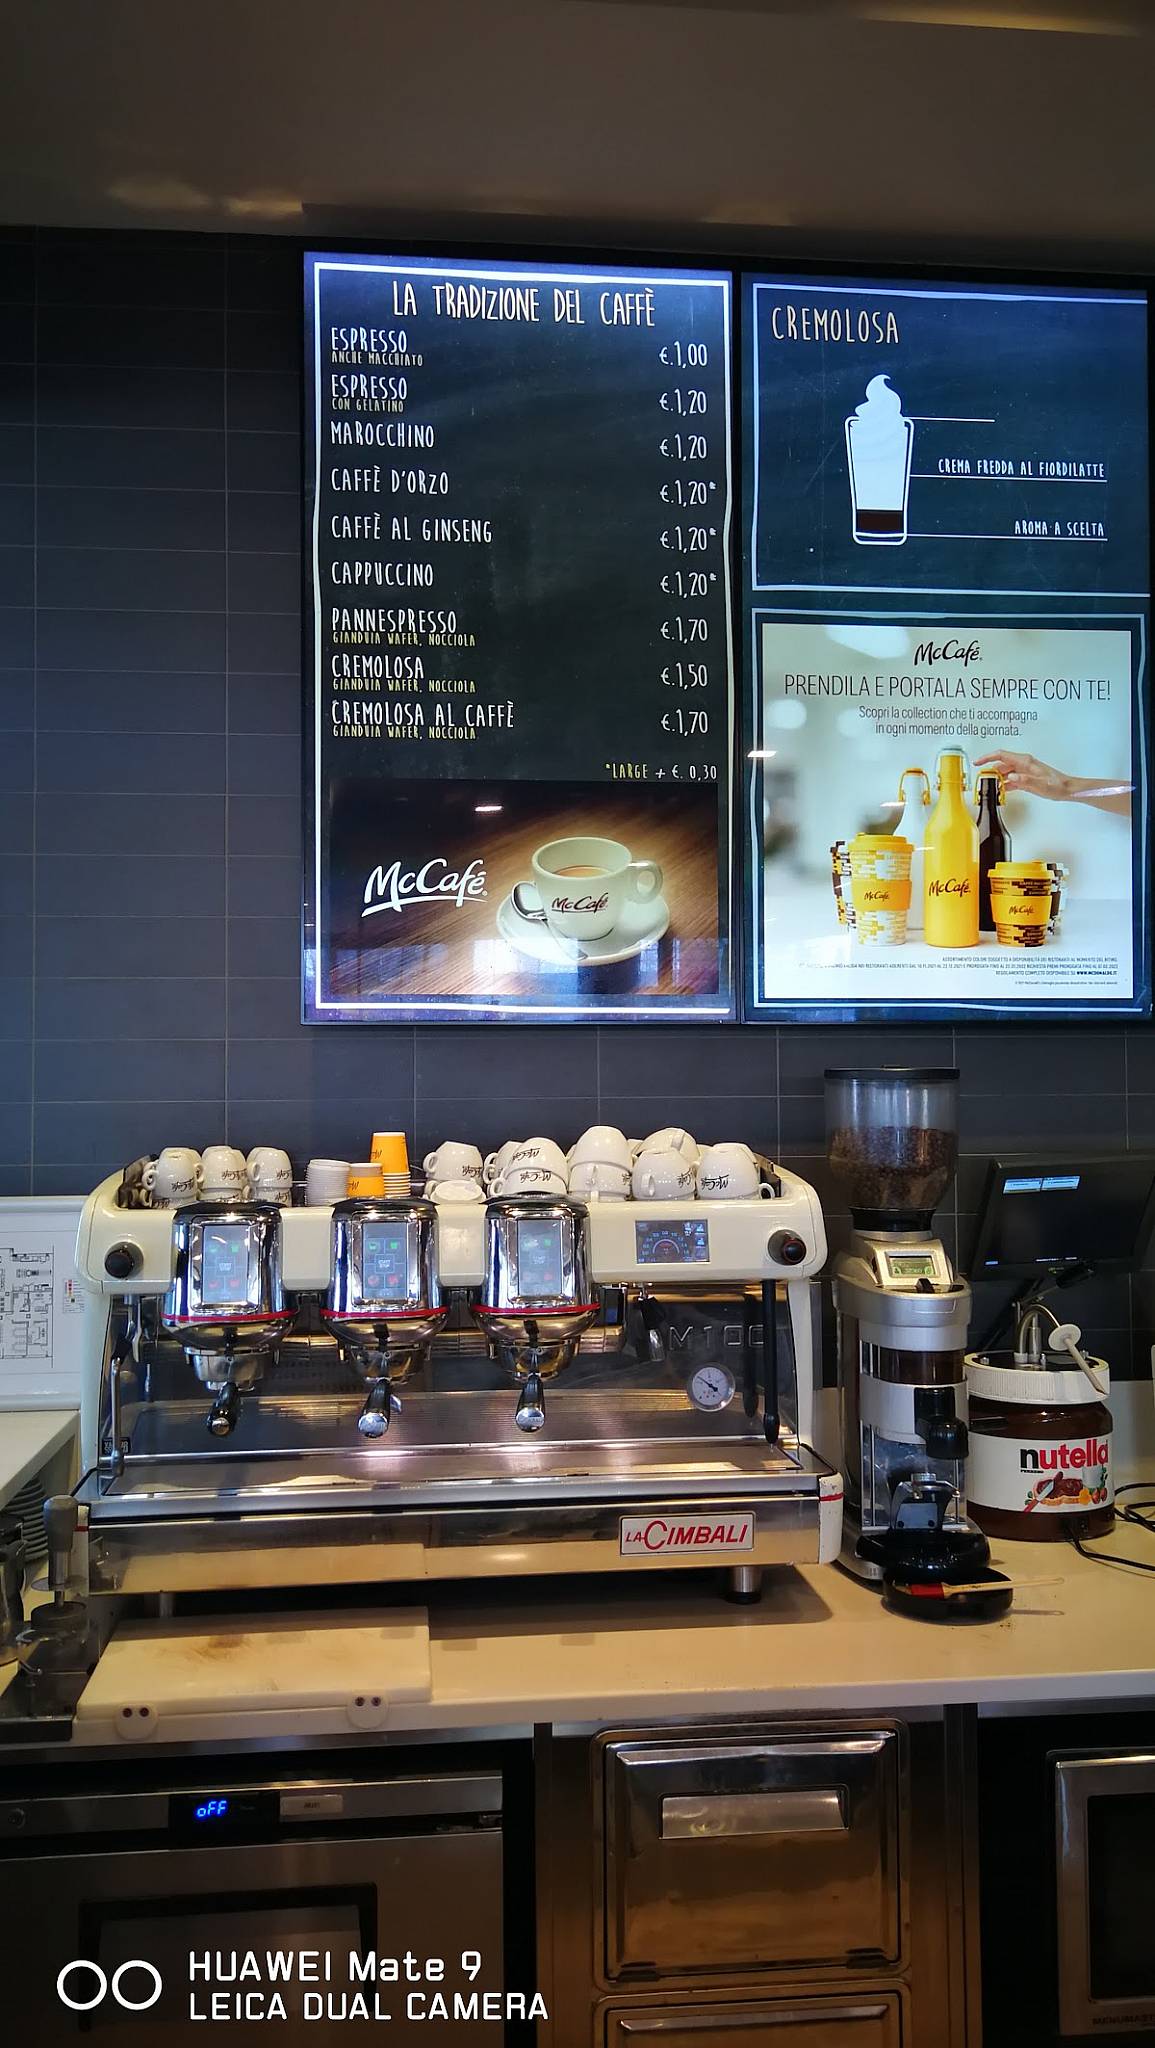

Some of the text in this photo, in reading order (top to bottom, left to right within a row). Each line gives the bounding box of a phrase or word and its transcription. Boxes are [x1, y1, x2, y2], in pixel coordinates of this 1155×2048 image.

[393, 281, 656, 327] LA TRADIZIONE DEL CAFFÈ
[771, 304, 900, 344] CREMOLOSA
[331, 327, 408, 353] ESPRESSO
[331, 352, 423, 367] ANCHE MACCHIATO
[331, 374, 408, 400] ESPRESSO
[331, 399, 404, 413] CON GELATINO
[331, 421, 435, 448] MAROCCHINO
[331, 465, 449, 495] CAFFÈ D'ORZO
[938, 458, 1105, 478] CREMA FREDDA AL FIORDILATTE
[331, 512, 493, 545] CAFFÈ AL GINSENG
[1015, 521, 1105, 538] AROMA A SCELTA
[331, 561, 434, 587] CAPPUCCINO
[331, 607, 457, 634] PANNESPRESSO
[333, 631, 381, 644] GIANDUIA
[428, 633, 476, 647] NOCCIOLA
[914, 639, 979, 667] McCafé
[331, 653, 425, 680] CREMOLOSA
[333, 678, 381, 691] GIANDUIA
[428, 680, 476, 694] NOCCIOLA
[784, 673, 1111, 702] PRENDILA E PORTALA SEMPRE CON TE!
[331, 700, 515, 728] CREMOLOSA AL CAFFÈ
[859, 705, 1038, 724] Scopri la collection che ti accompagna
[333, 725, 381, 738] GIANDUIA
[428, 727, 476, 741] NOCCIOLA
[875, 722, 1022, 738] in ogni momento della giornata.
[362, 858, 489, 914] McCafé
[929, 878, 972, 898] McCafé
[551, 892, 609, 912] McCafé
[1020, 1439, 1108, 1469] nutella
